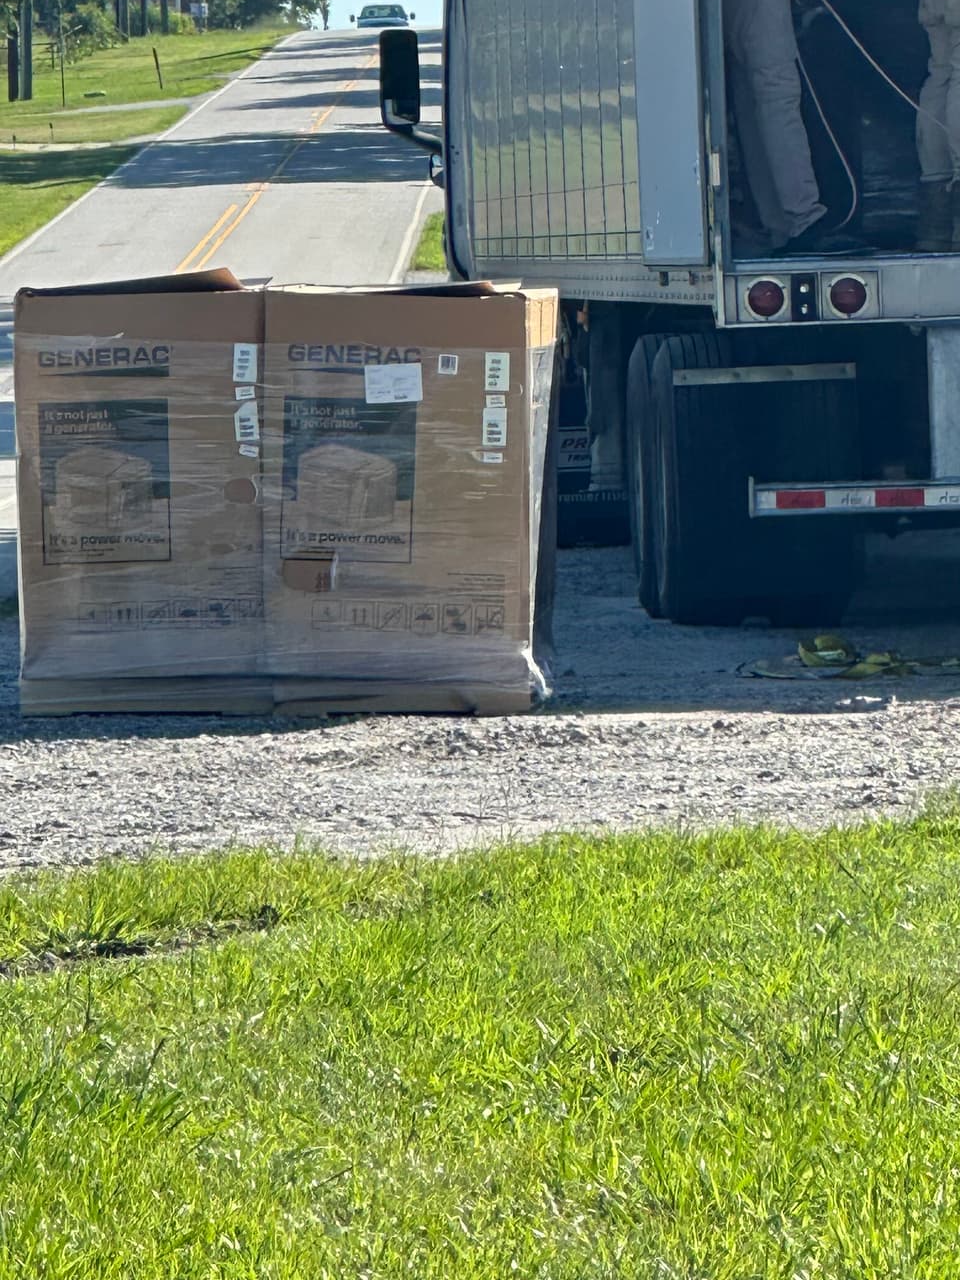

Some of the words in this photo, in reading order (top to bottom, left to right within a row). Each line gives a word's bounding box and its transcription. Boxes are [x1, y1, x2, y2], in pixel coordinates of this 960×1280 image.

[37, 345, 170, 368] GENERAC
[287, 344, 422, 365] GENERAC
[333, 405, 356, 419] just
[80, 532, 122, 548] power
[318, 532, 361, 544] power
[363, 533, 406, 545] move.
